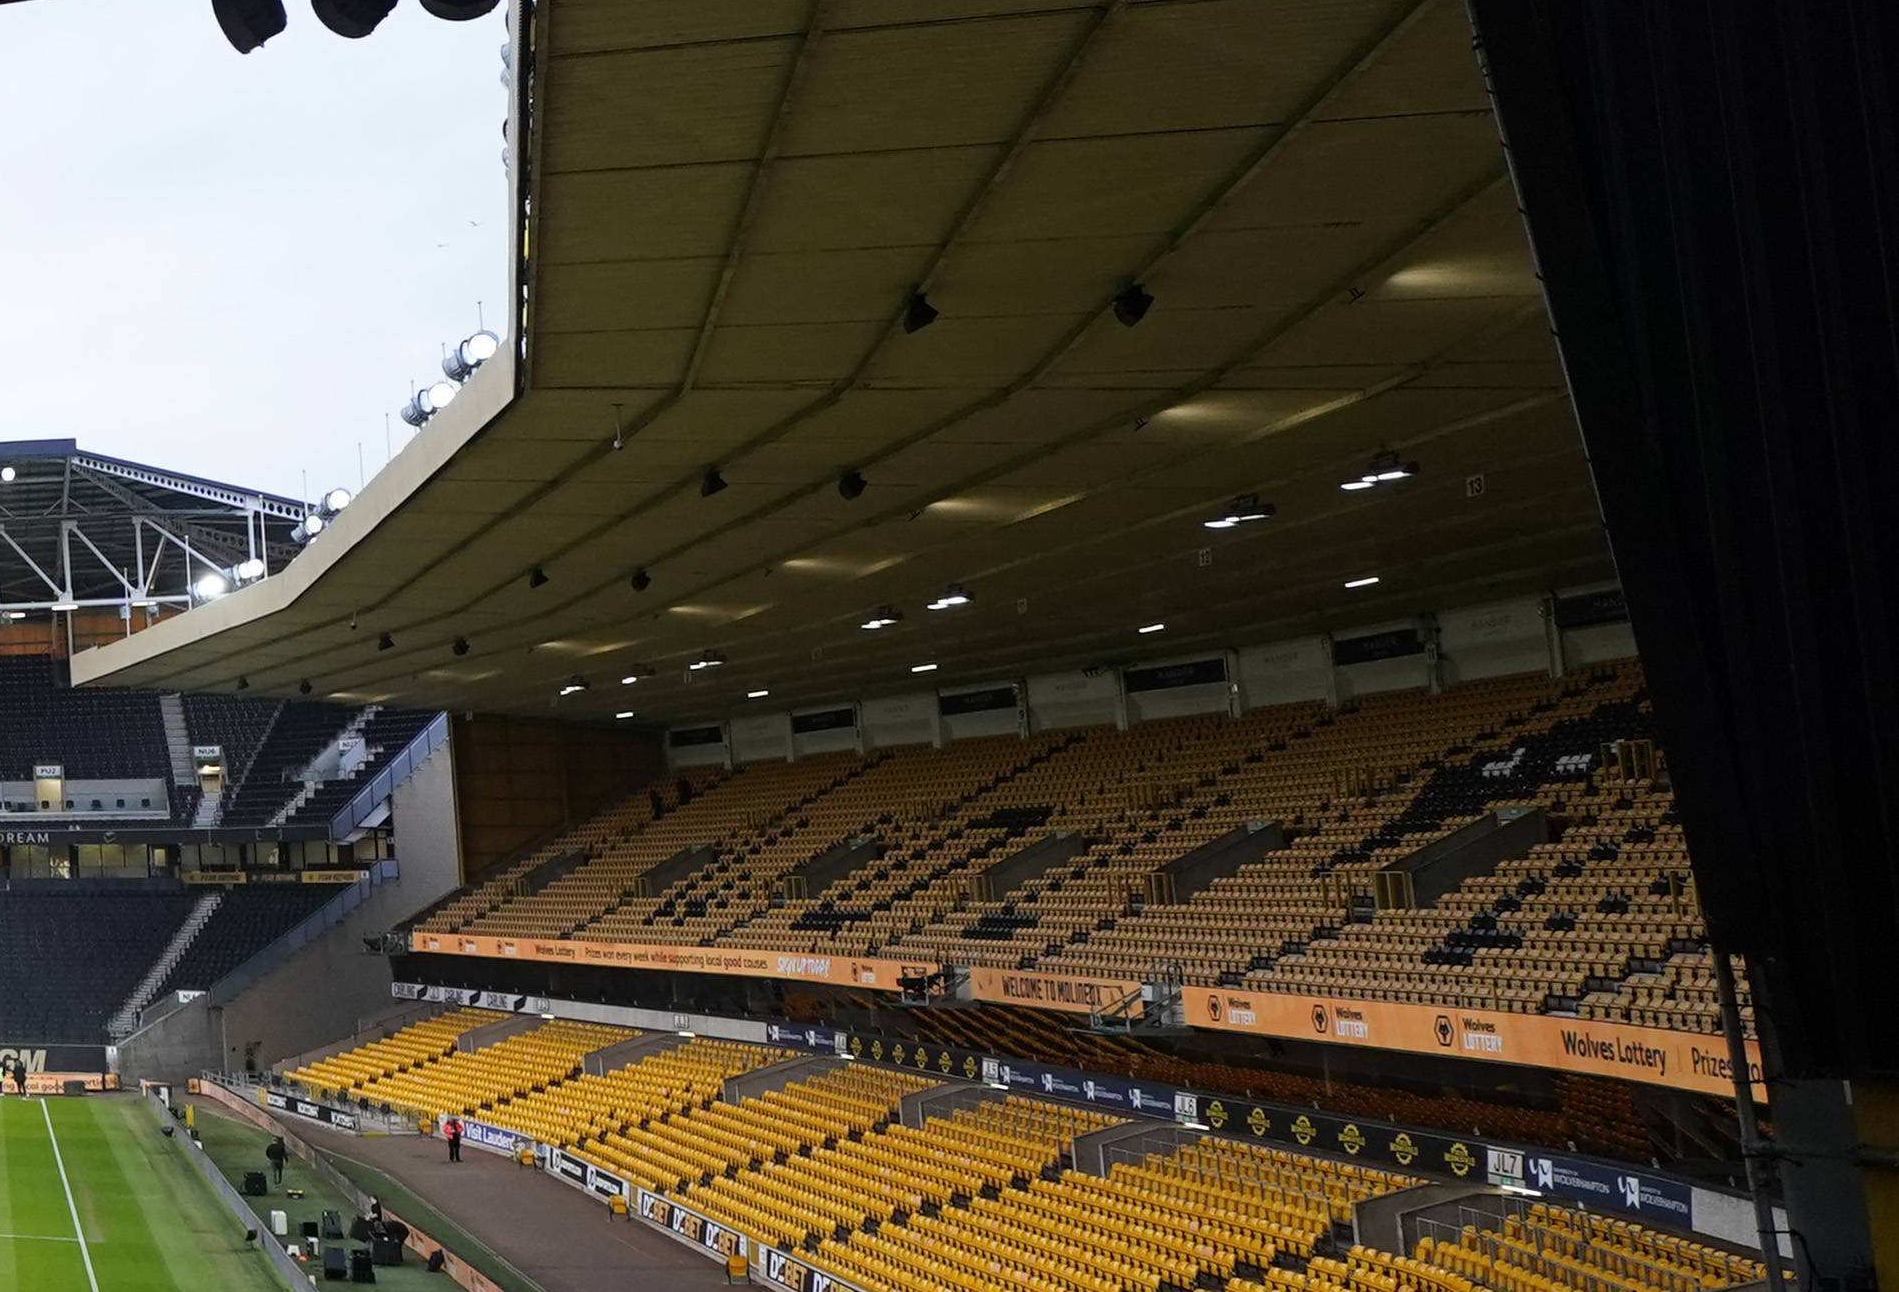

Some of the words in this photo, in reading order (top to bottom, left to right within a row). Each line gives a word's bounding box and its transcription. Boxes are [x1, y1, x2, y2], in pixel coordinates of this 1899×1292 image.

[724, 957, 742, 969] good
[1003, 976, 1042, 1001] WELCOME
[1045, 979, 1055, 1001] TO
[1227, 998, 1251, 1010] Wolves
[1336, 1008, 1362, 1020] Wolves
[1463, 1018, 1495, 1033] Wolves
[1463, 1033, 1502, 1053] LOTTERY
[1561, 1030, 1615, 1062] Wolves
[1618, 1037, 1666, 1076] Lottery
[1692, 1047, 1732, 1079] Prizes
[1178, 1096, 1195, 1116] JL6
[465, 1122, 482, 1141] Visit
[1494, 1154, 1518, 1174] JL7
